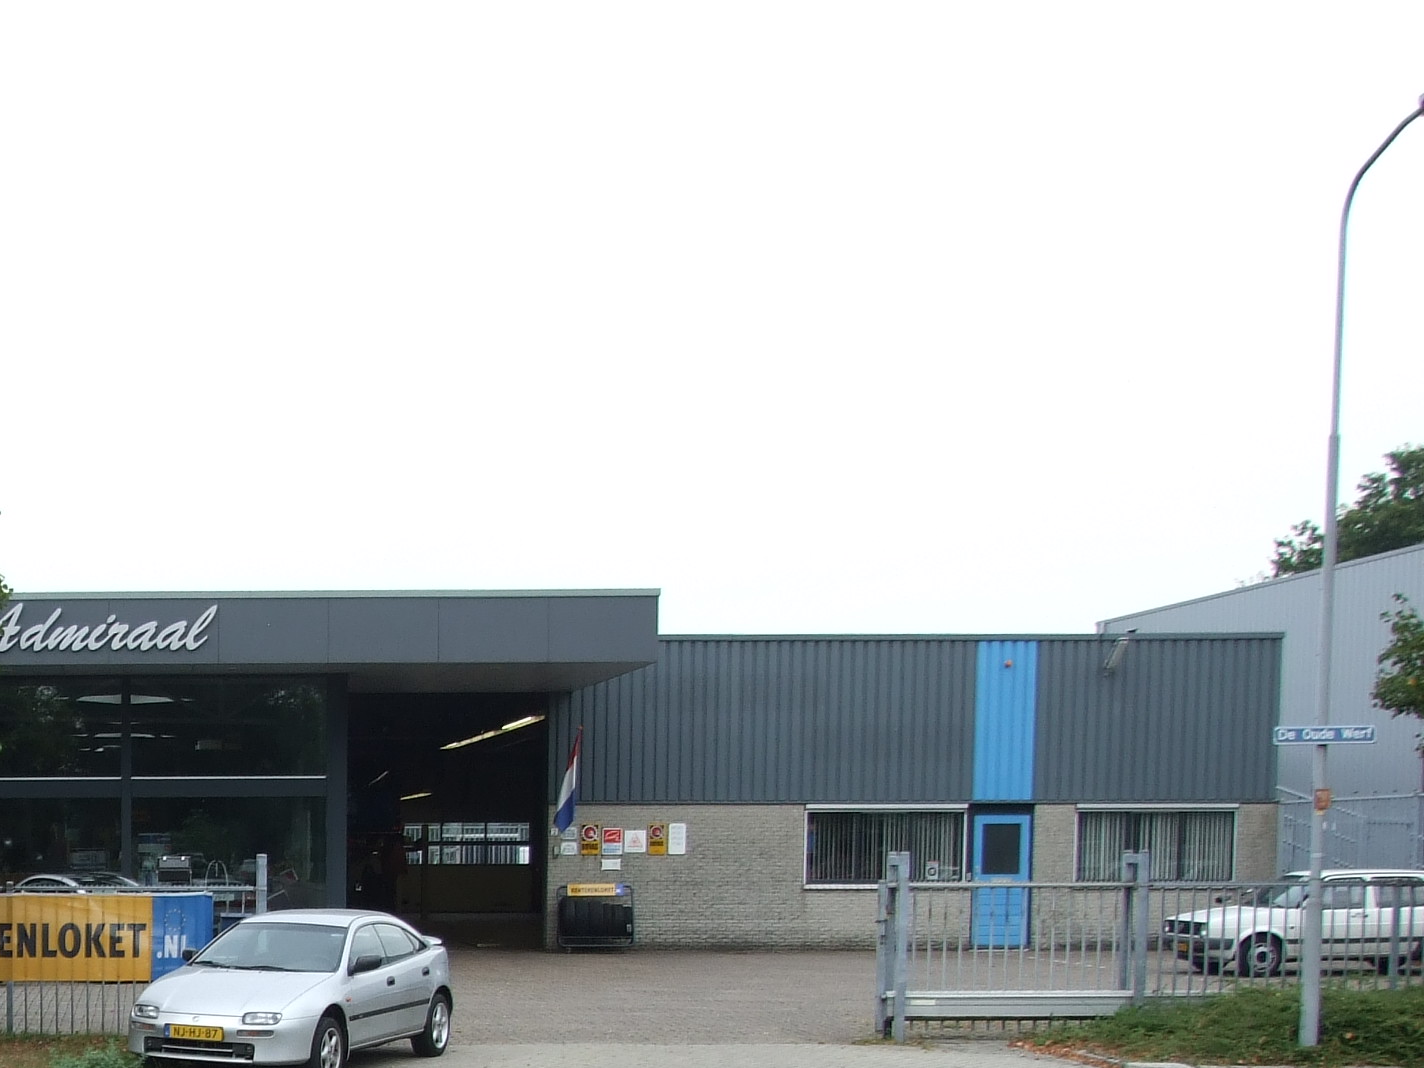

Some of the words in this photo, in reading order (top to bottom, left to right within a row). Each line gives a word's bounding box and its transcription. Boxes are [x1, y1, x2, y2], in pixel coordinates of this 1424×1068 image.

[1277, 729, 1296, 741] De
[1302, 728, 1335, 740] Oude
[1342, 727, 1373, 739] Werf
